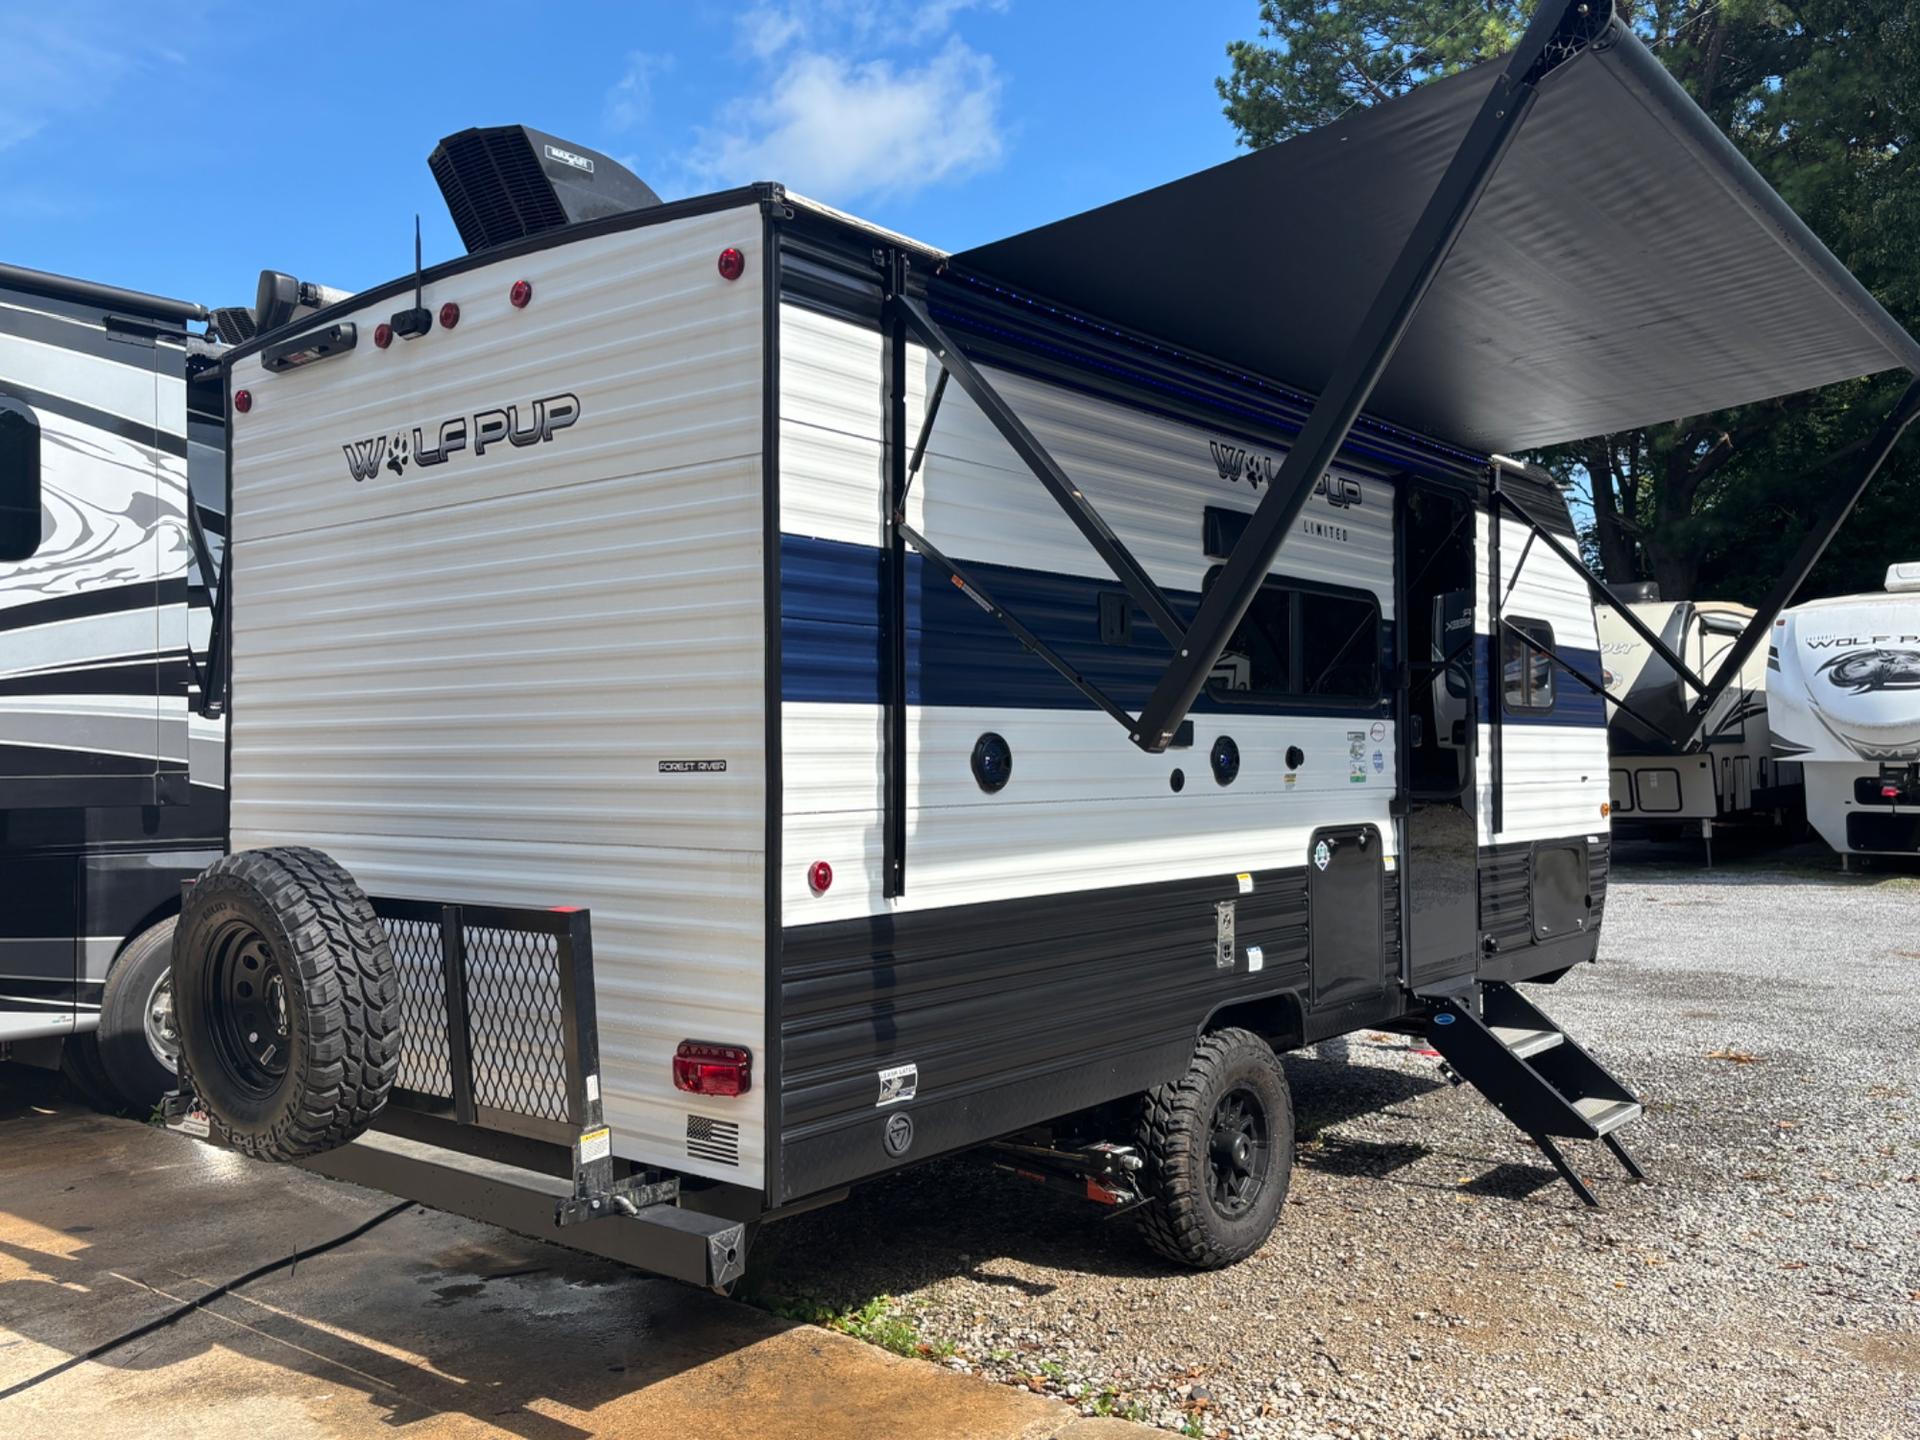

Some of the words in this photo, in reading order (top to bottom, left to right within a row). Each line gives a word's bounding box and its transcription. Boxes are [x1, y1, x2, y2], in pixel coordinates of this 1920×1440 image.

[474, 392, 581, 456] PUP
[1303, 520, 1348, 542] LIMITED
[1807, 635, 1891, 650] WOLF
[659, 762, 695, 772] FOREST
[698, 761, 725, 771] RIVER
